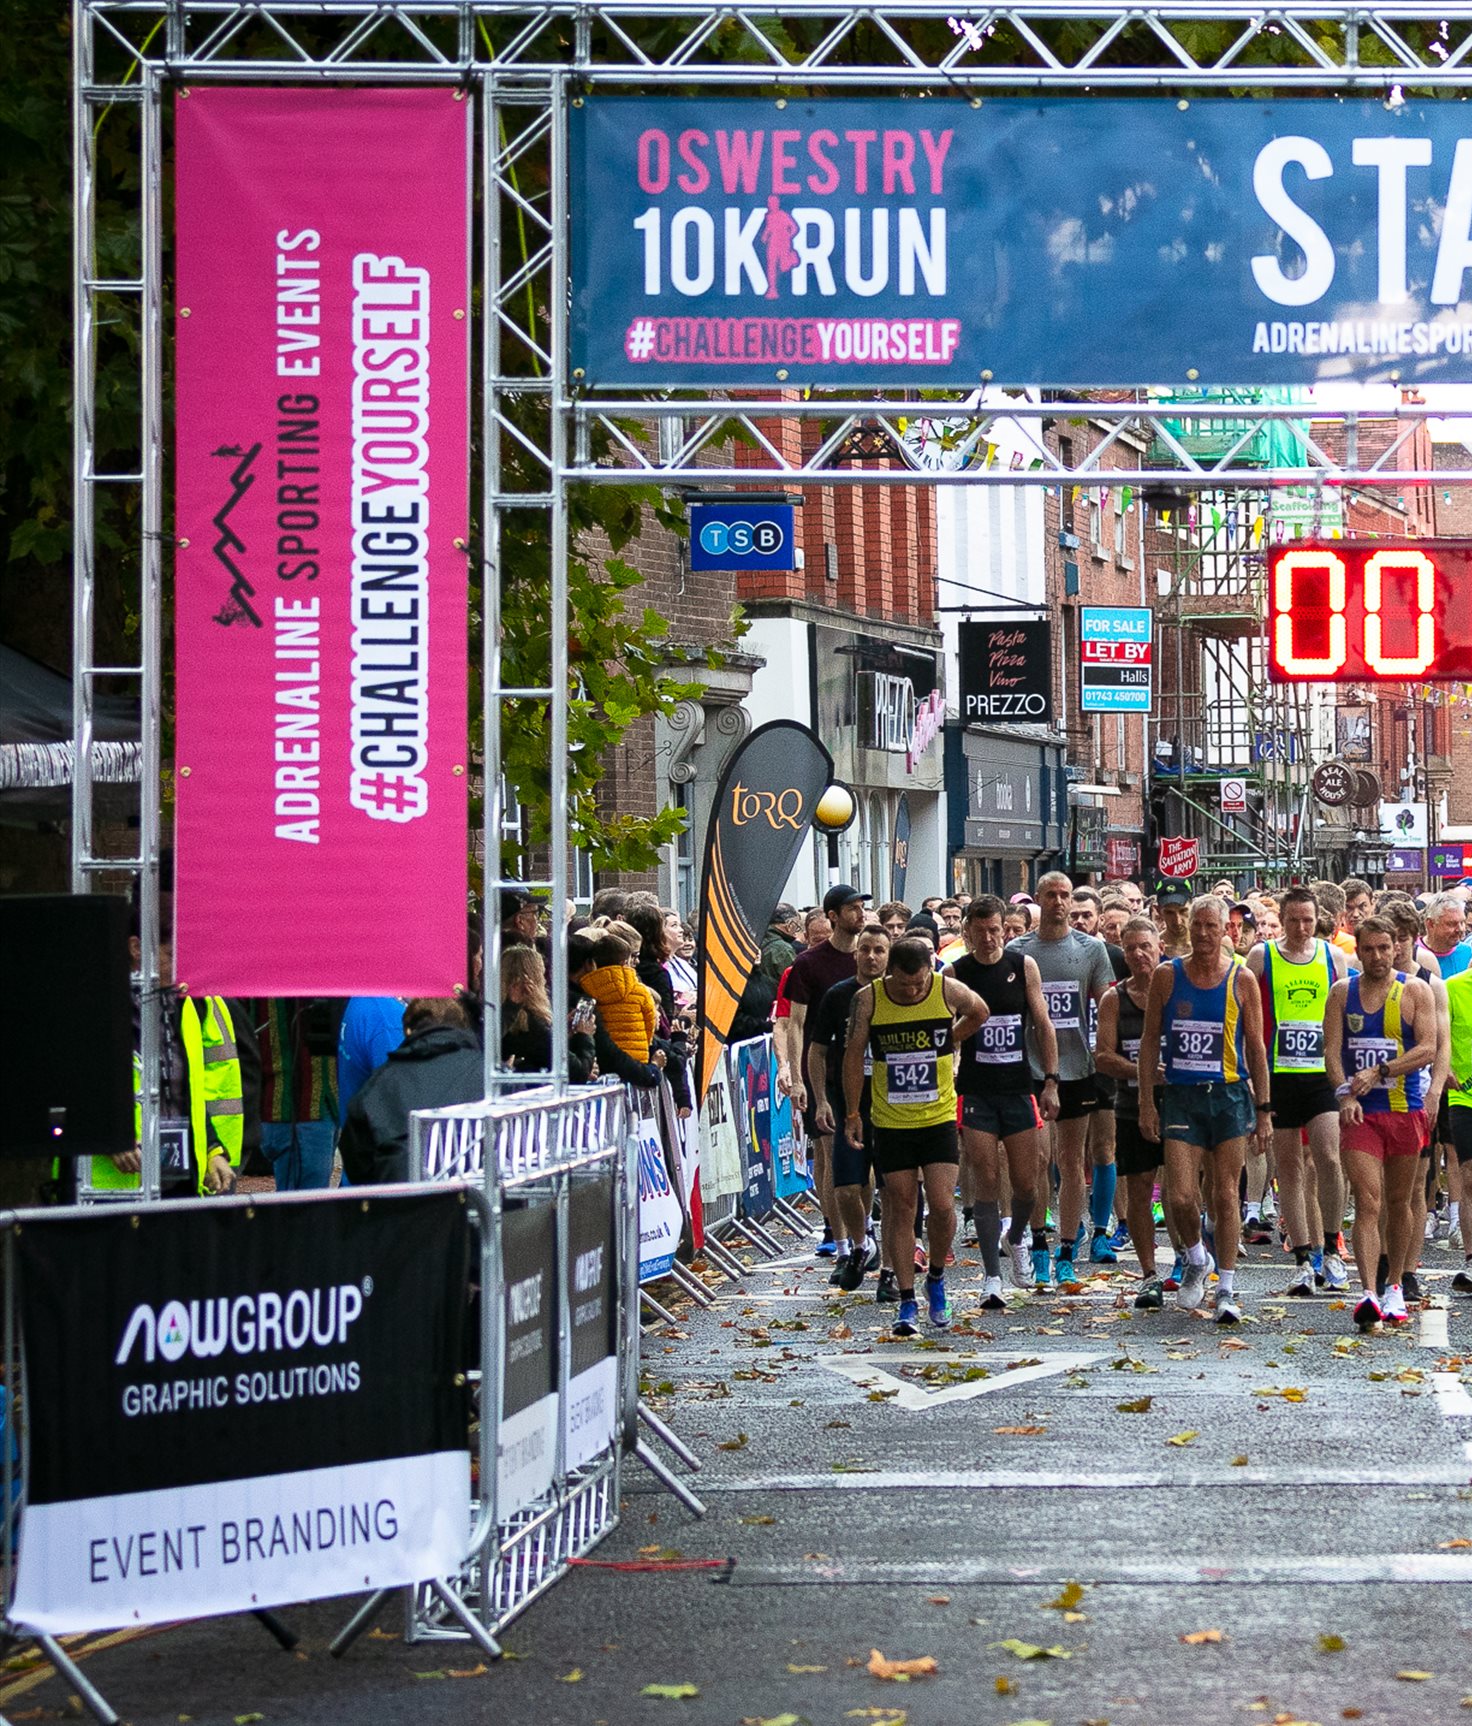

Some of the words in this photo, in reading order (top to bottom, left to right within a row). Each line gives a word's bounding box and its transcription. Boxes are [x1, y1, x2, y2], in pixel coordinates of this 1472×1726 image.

[637, 129, 954, 194] OSWESTRY
[633, 207, 769, 296] 10K
[791, 208, 947, 296] RUN
[276, 227, 321, 377] EVENTS
[276, 392, 320, 581] SPORTING
[1085, 620, 1110, 633] FOR
[1113, 620, 1145, 633] SALE
[988, 630, 1027, 649] Pasta
[988, 649, 1027, 669] Pizza
[1085, 642, 1119, 658] LET
[1125, 643, 1148, 659] BY
[989, 670, 1027, 688] Vino
[1120, 670, 1148, 683] Halls
[966, 693, 1046, 716] PREZZO
[1085, 691, 1112, 701] 01743
[275, 596, 320, 845] ADRENALINE
[1321, 766, 1344, 778] REAL
[1320, 787, 1346, 799] HOUSE
[1161, 845, 1196, 869] SALVATION
[1168, 841, 1182, 854] THE
[1173, 857, 1194, 876] ARMY
[984, 1026, 1015, 1047] 805
[1179, 1032, 1214, 1054] 382
[1285, 1031, 1317, 1051] 562
[1355, 1049, 1388, 1070] 503
[895, 1064, 930, 1086] 542
[122, 1376, 229, 1417] GRAPHIC
[235, 1362, 361, 1402] SOLUTIONS
[89, 1525, 207, 1584] EVENT
[222, 1498, 399, 1565] BRANDING
